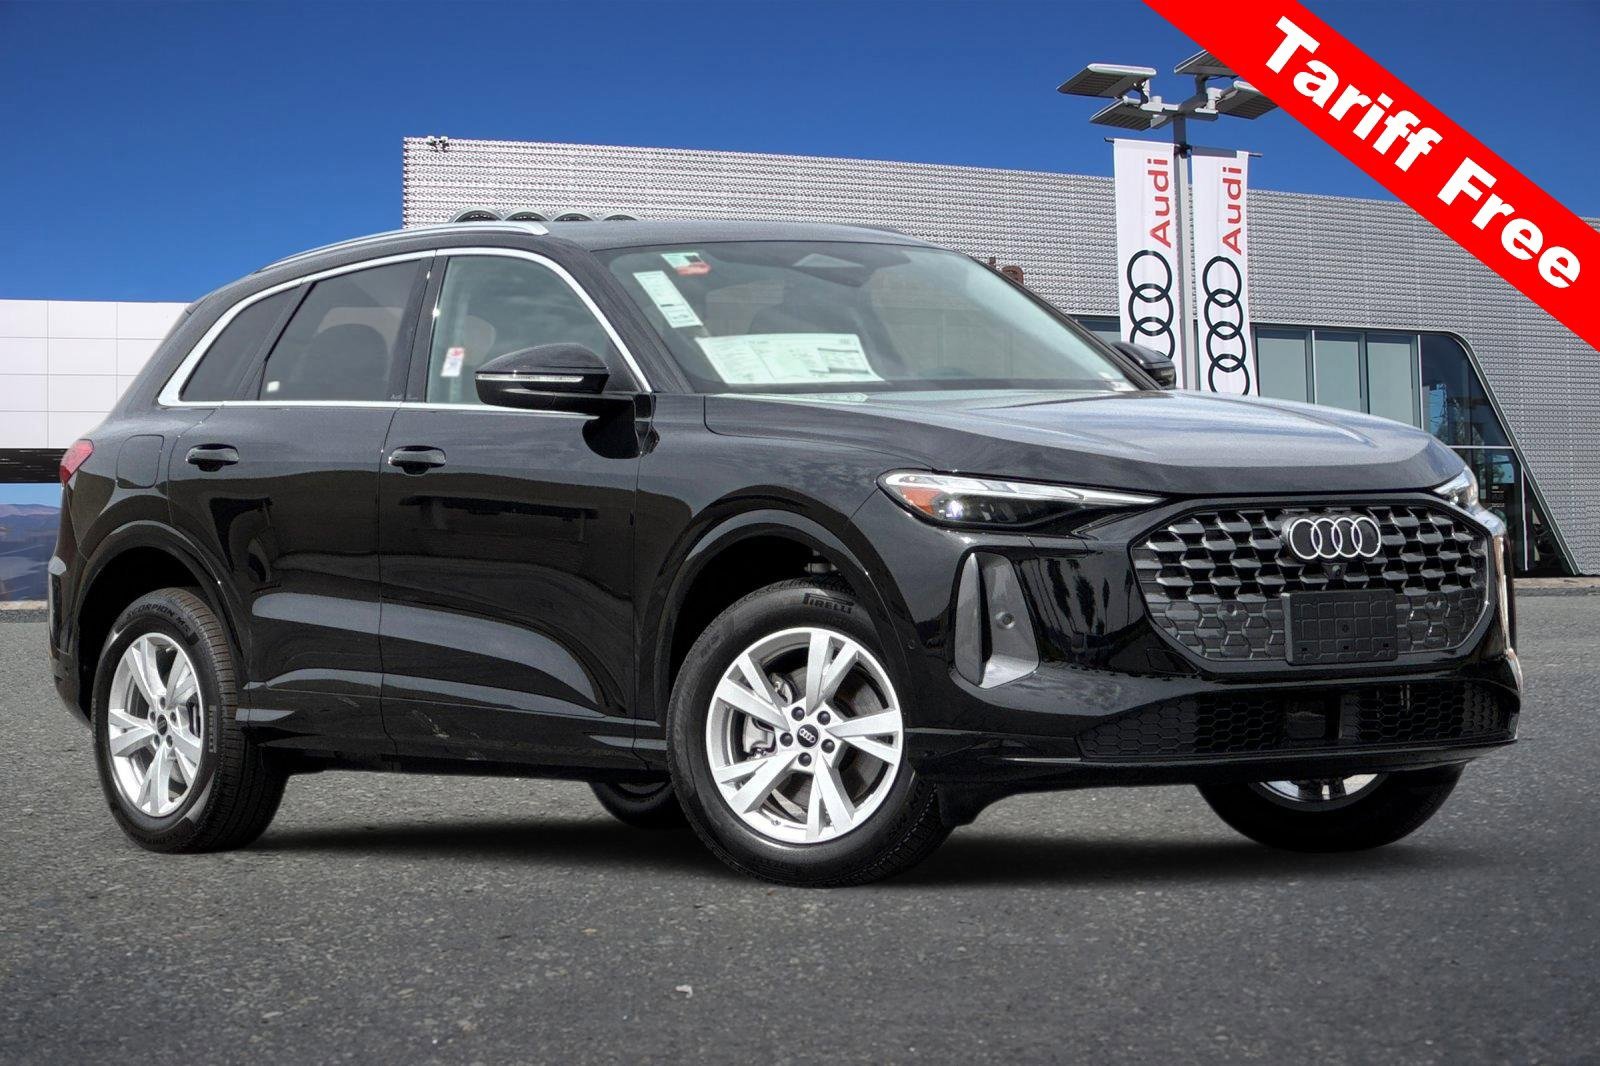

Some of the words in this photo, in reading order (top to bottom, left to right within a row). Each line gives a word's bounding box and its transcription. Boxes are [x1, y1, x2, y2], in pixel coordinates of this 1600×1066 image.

[1147, 158, 1172, 249] Audi
[1222, 166, 1242, 256] Audi
[802, 592, 854, 615] PIRELLI
